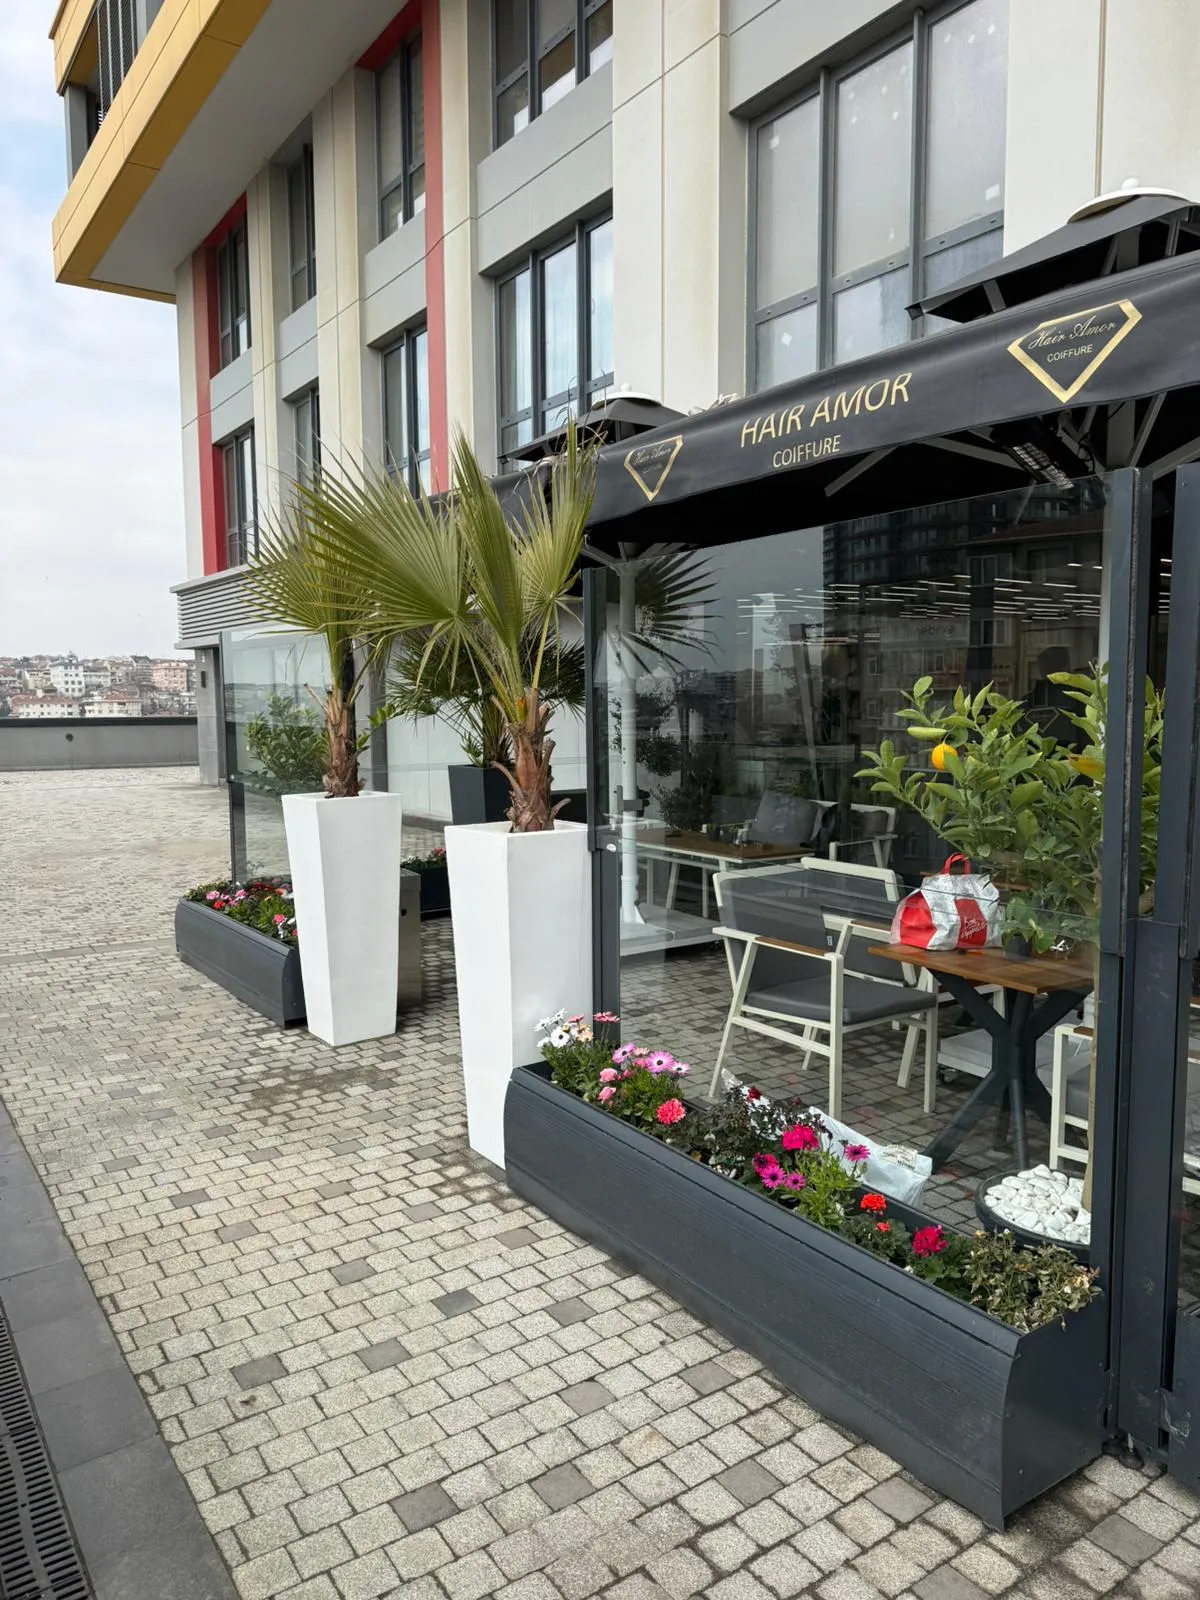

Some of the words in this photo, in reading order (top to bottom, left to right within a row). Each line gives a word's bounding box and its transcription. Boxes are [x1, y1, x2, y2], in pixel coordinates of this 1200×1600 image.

[1028, 326, 1066, 350] Hair
[1069, 315, 1117, 340] Amor
[1047, 344, 1094, 362] COIFFURE
[740, 404, 806, 448] HAIR
[810, 372, 913, 428] AMOR
[772, 434, 842, 468] COIFFURE
